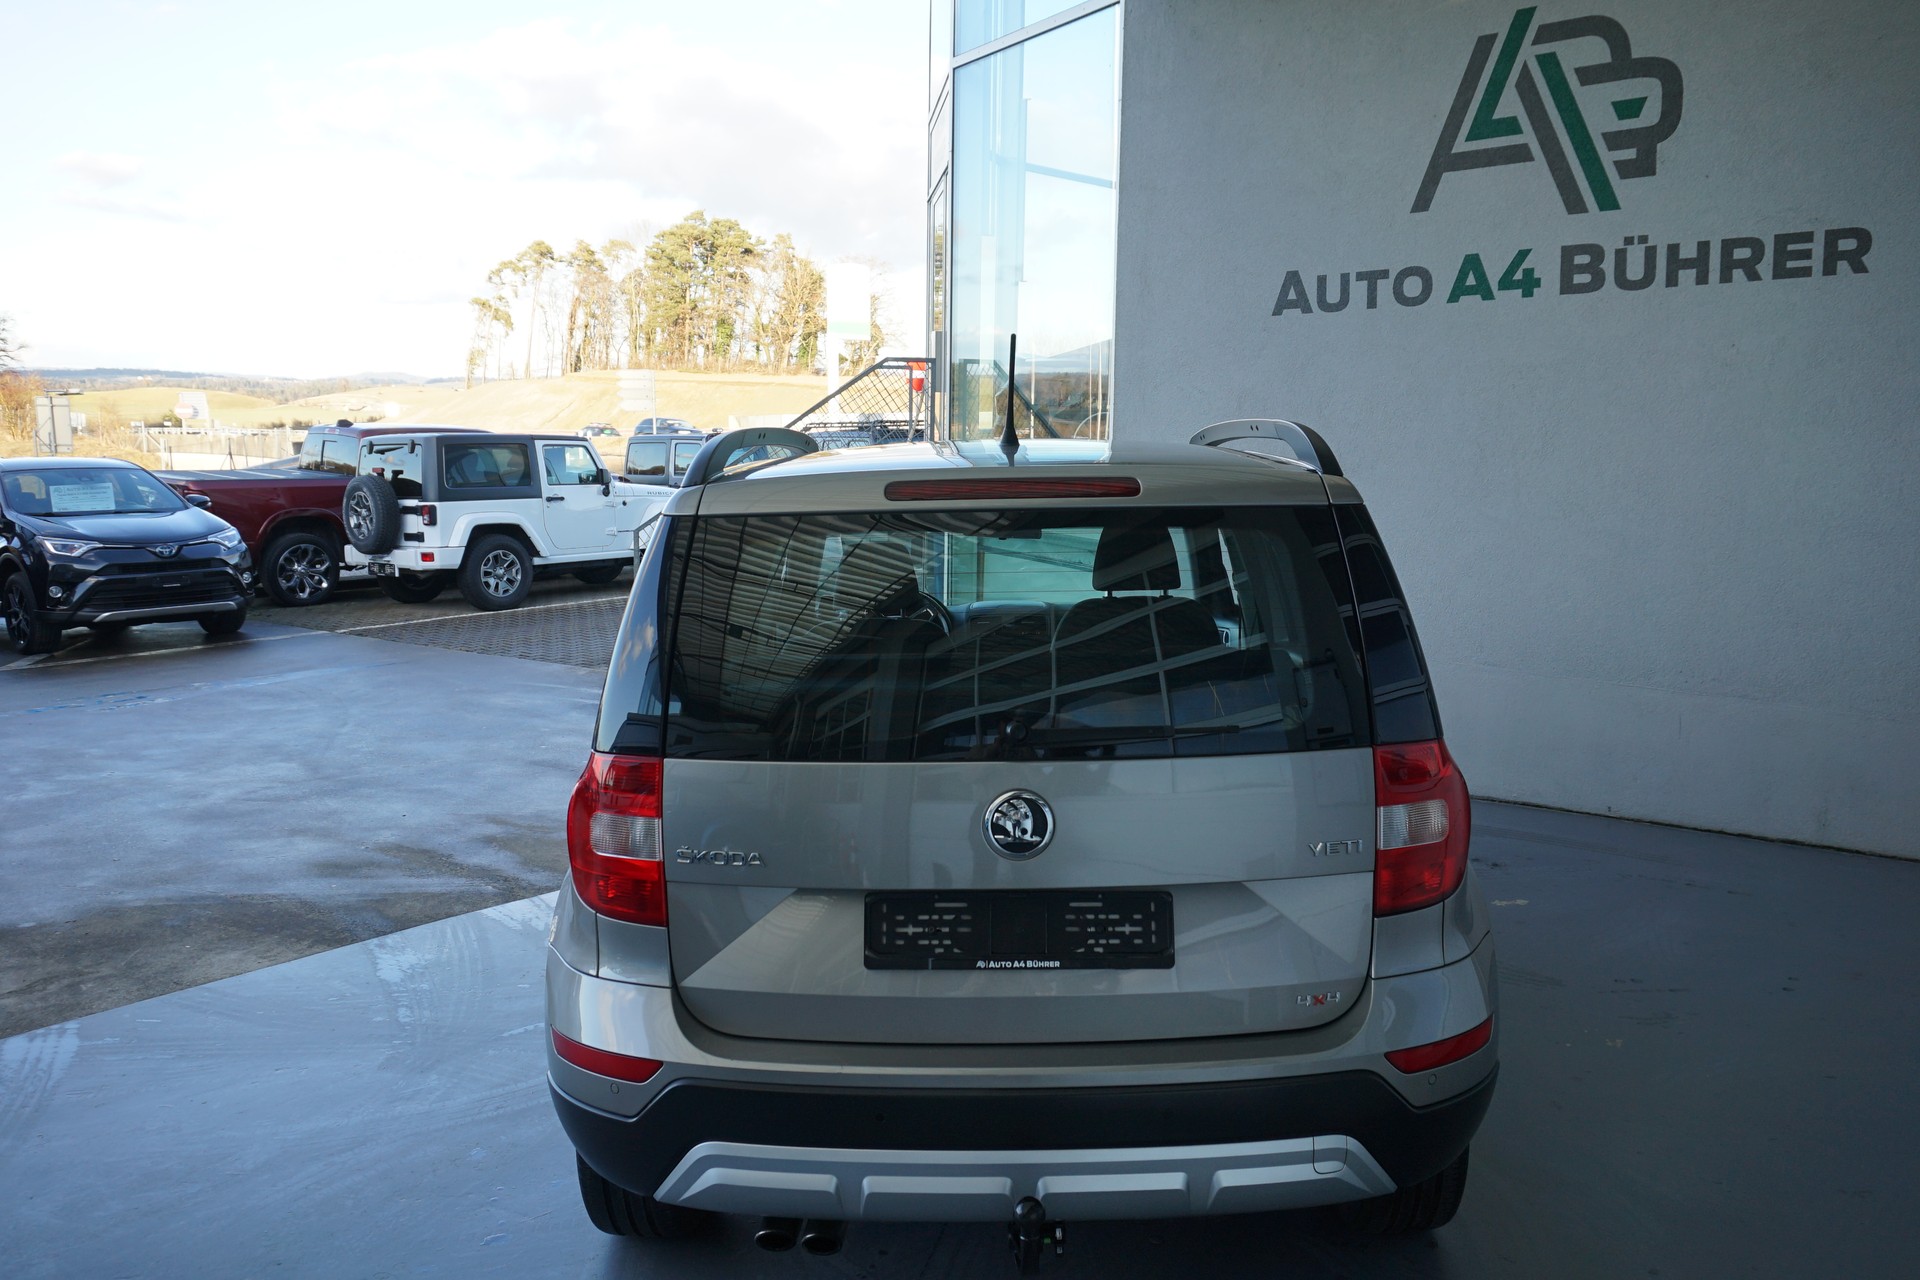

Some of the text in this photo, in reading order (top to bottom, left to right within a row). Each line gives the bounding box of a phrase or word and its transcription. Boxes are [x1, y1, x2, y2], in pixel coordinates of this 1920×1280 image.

[1271, 227, 1873, 317] AUTO A4 BÜHRER
[676, 845, 765, 866] ŠKODA
[1308, 839, 1363, 857] YETI
[989, 961, 1012, 969] AUTO
[1026, 960, 1060, 968] BÜHRER
